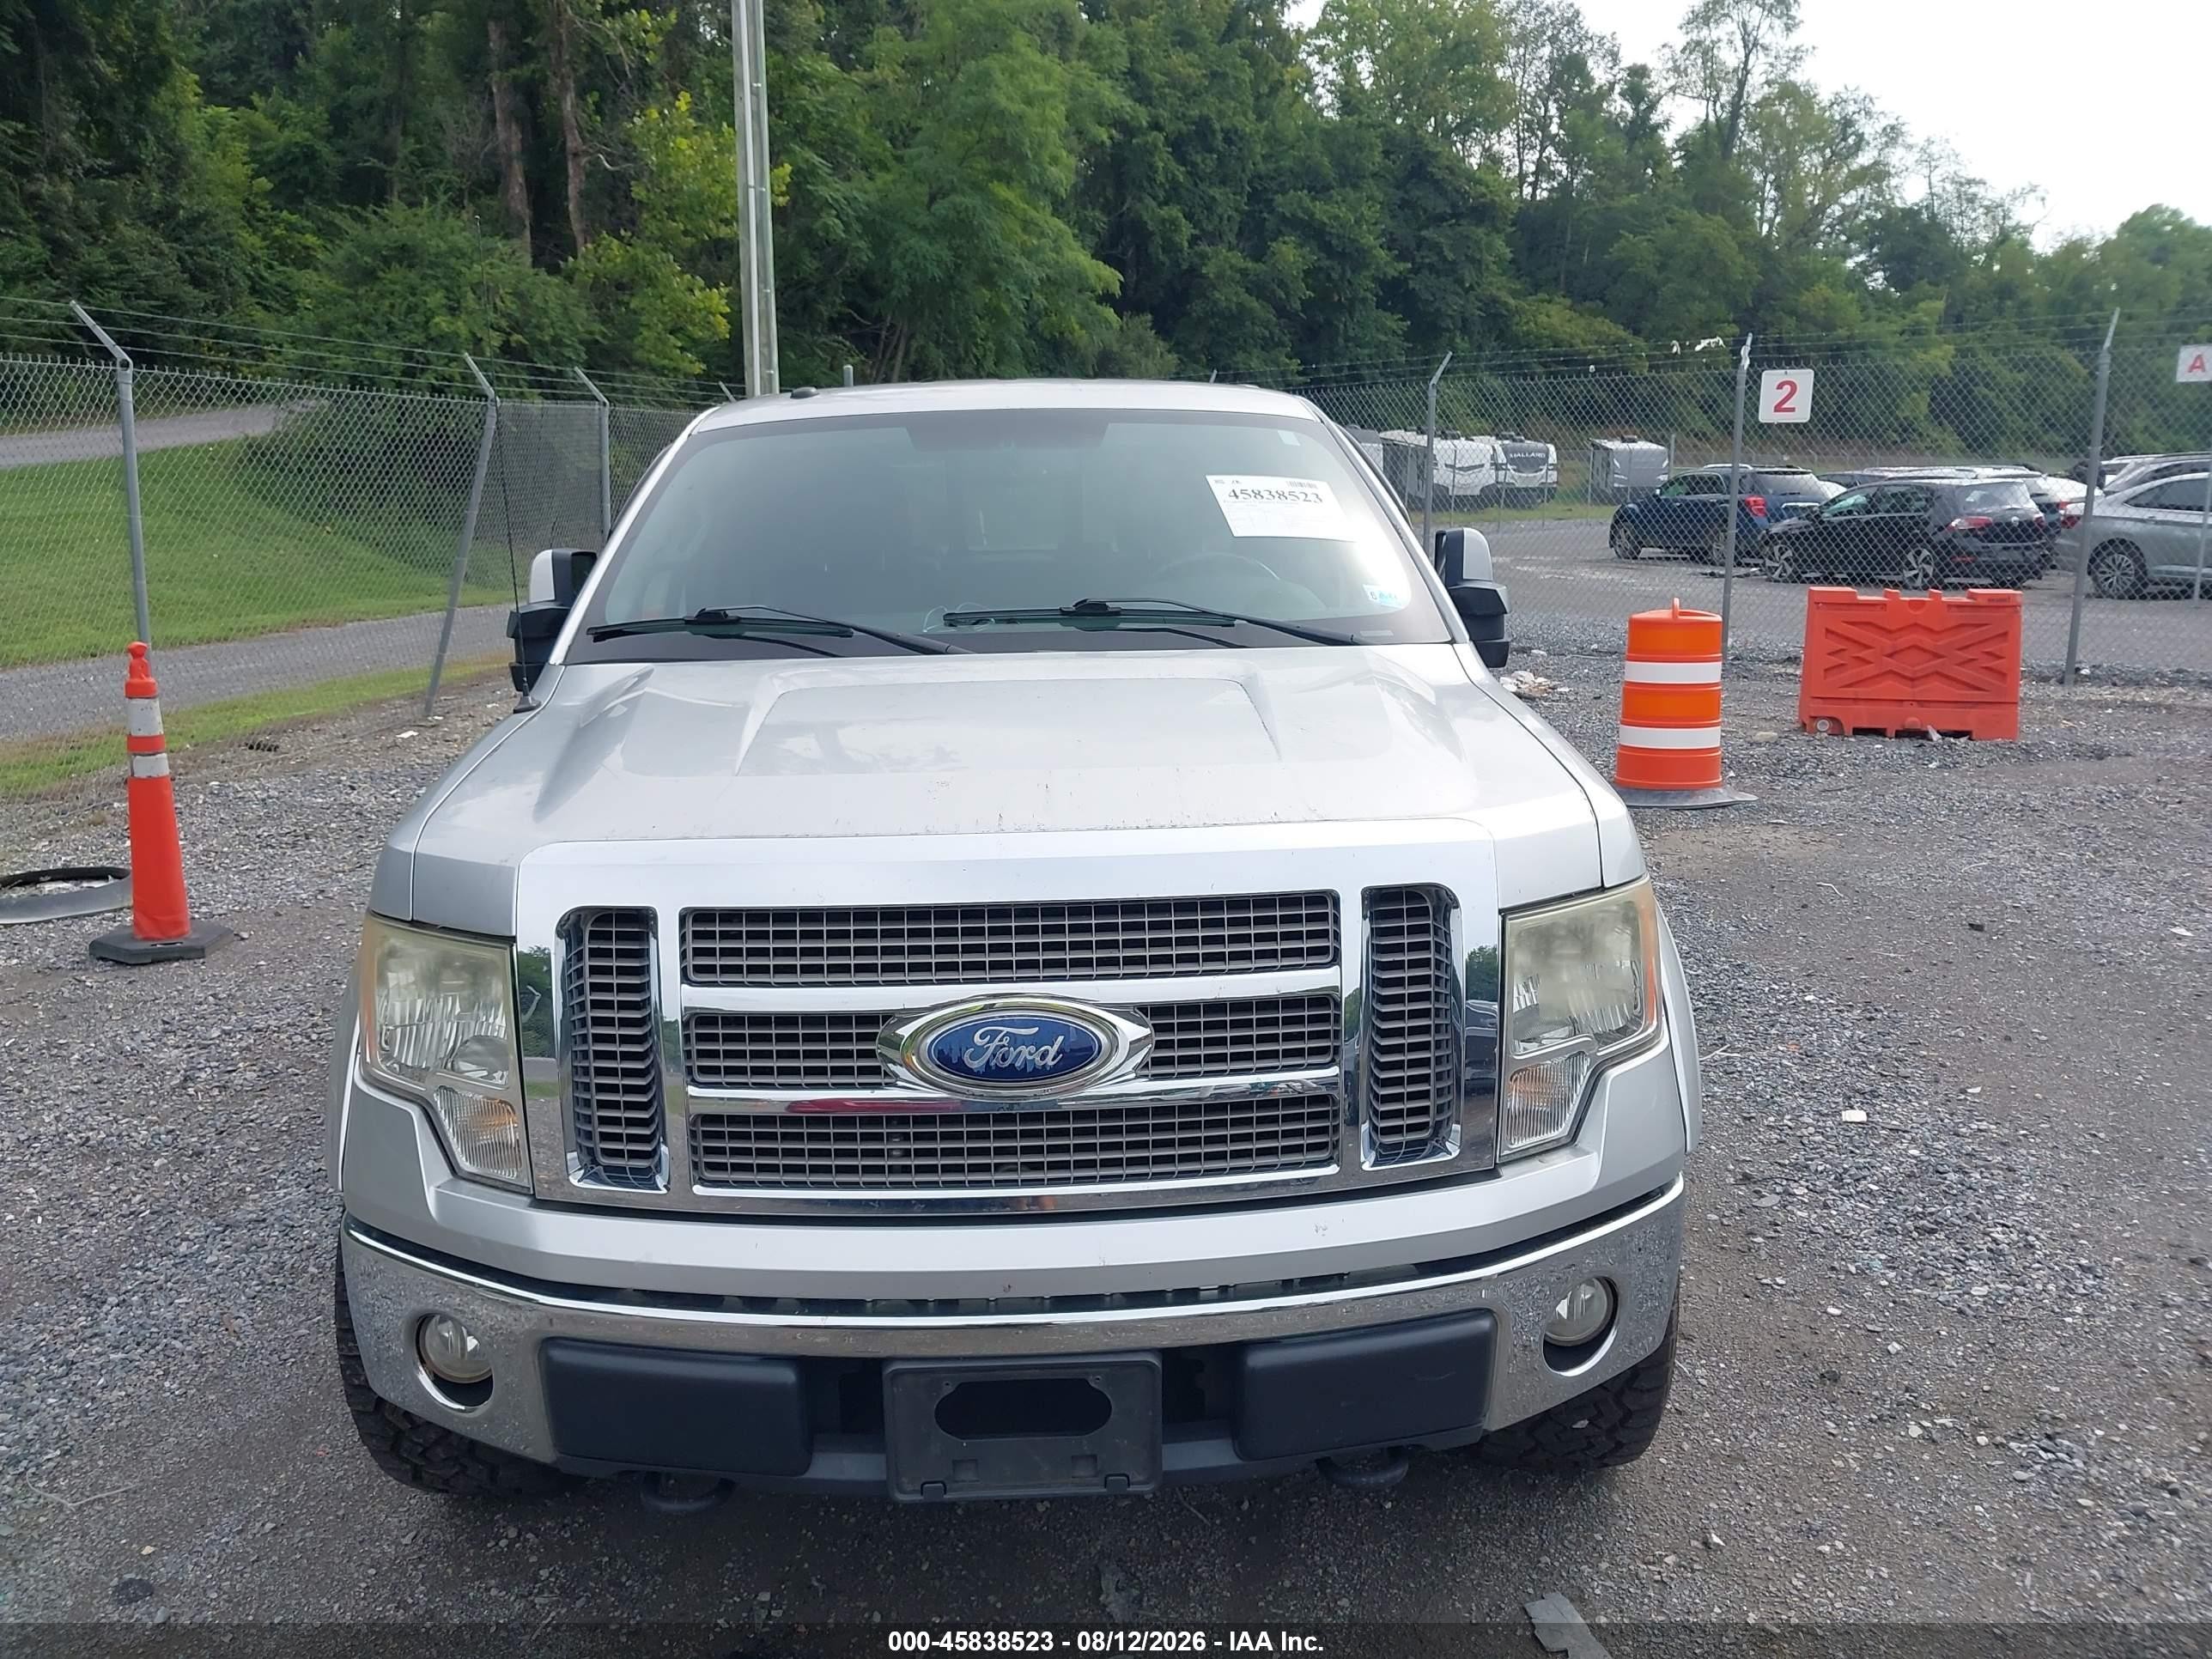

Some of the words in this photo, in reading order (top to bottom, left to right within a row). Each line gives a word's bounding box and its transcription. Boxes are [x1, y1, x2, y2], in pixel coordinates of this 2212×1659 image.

[2187, 354, 2206, 373] A
[1774, 380, 1797, 412] 2
[1228, 488, 1323, 504] 45838523
[963, 1025, 1065, 1070] Ford
